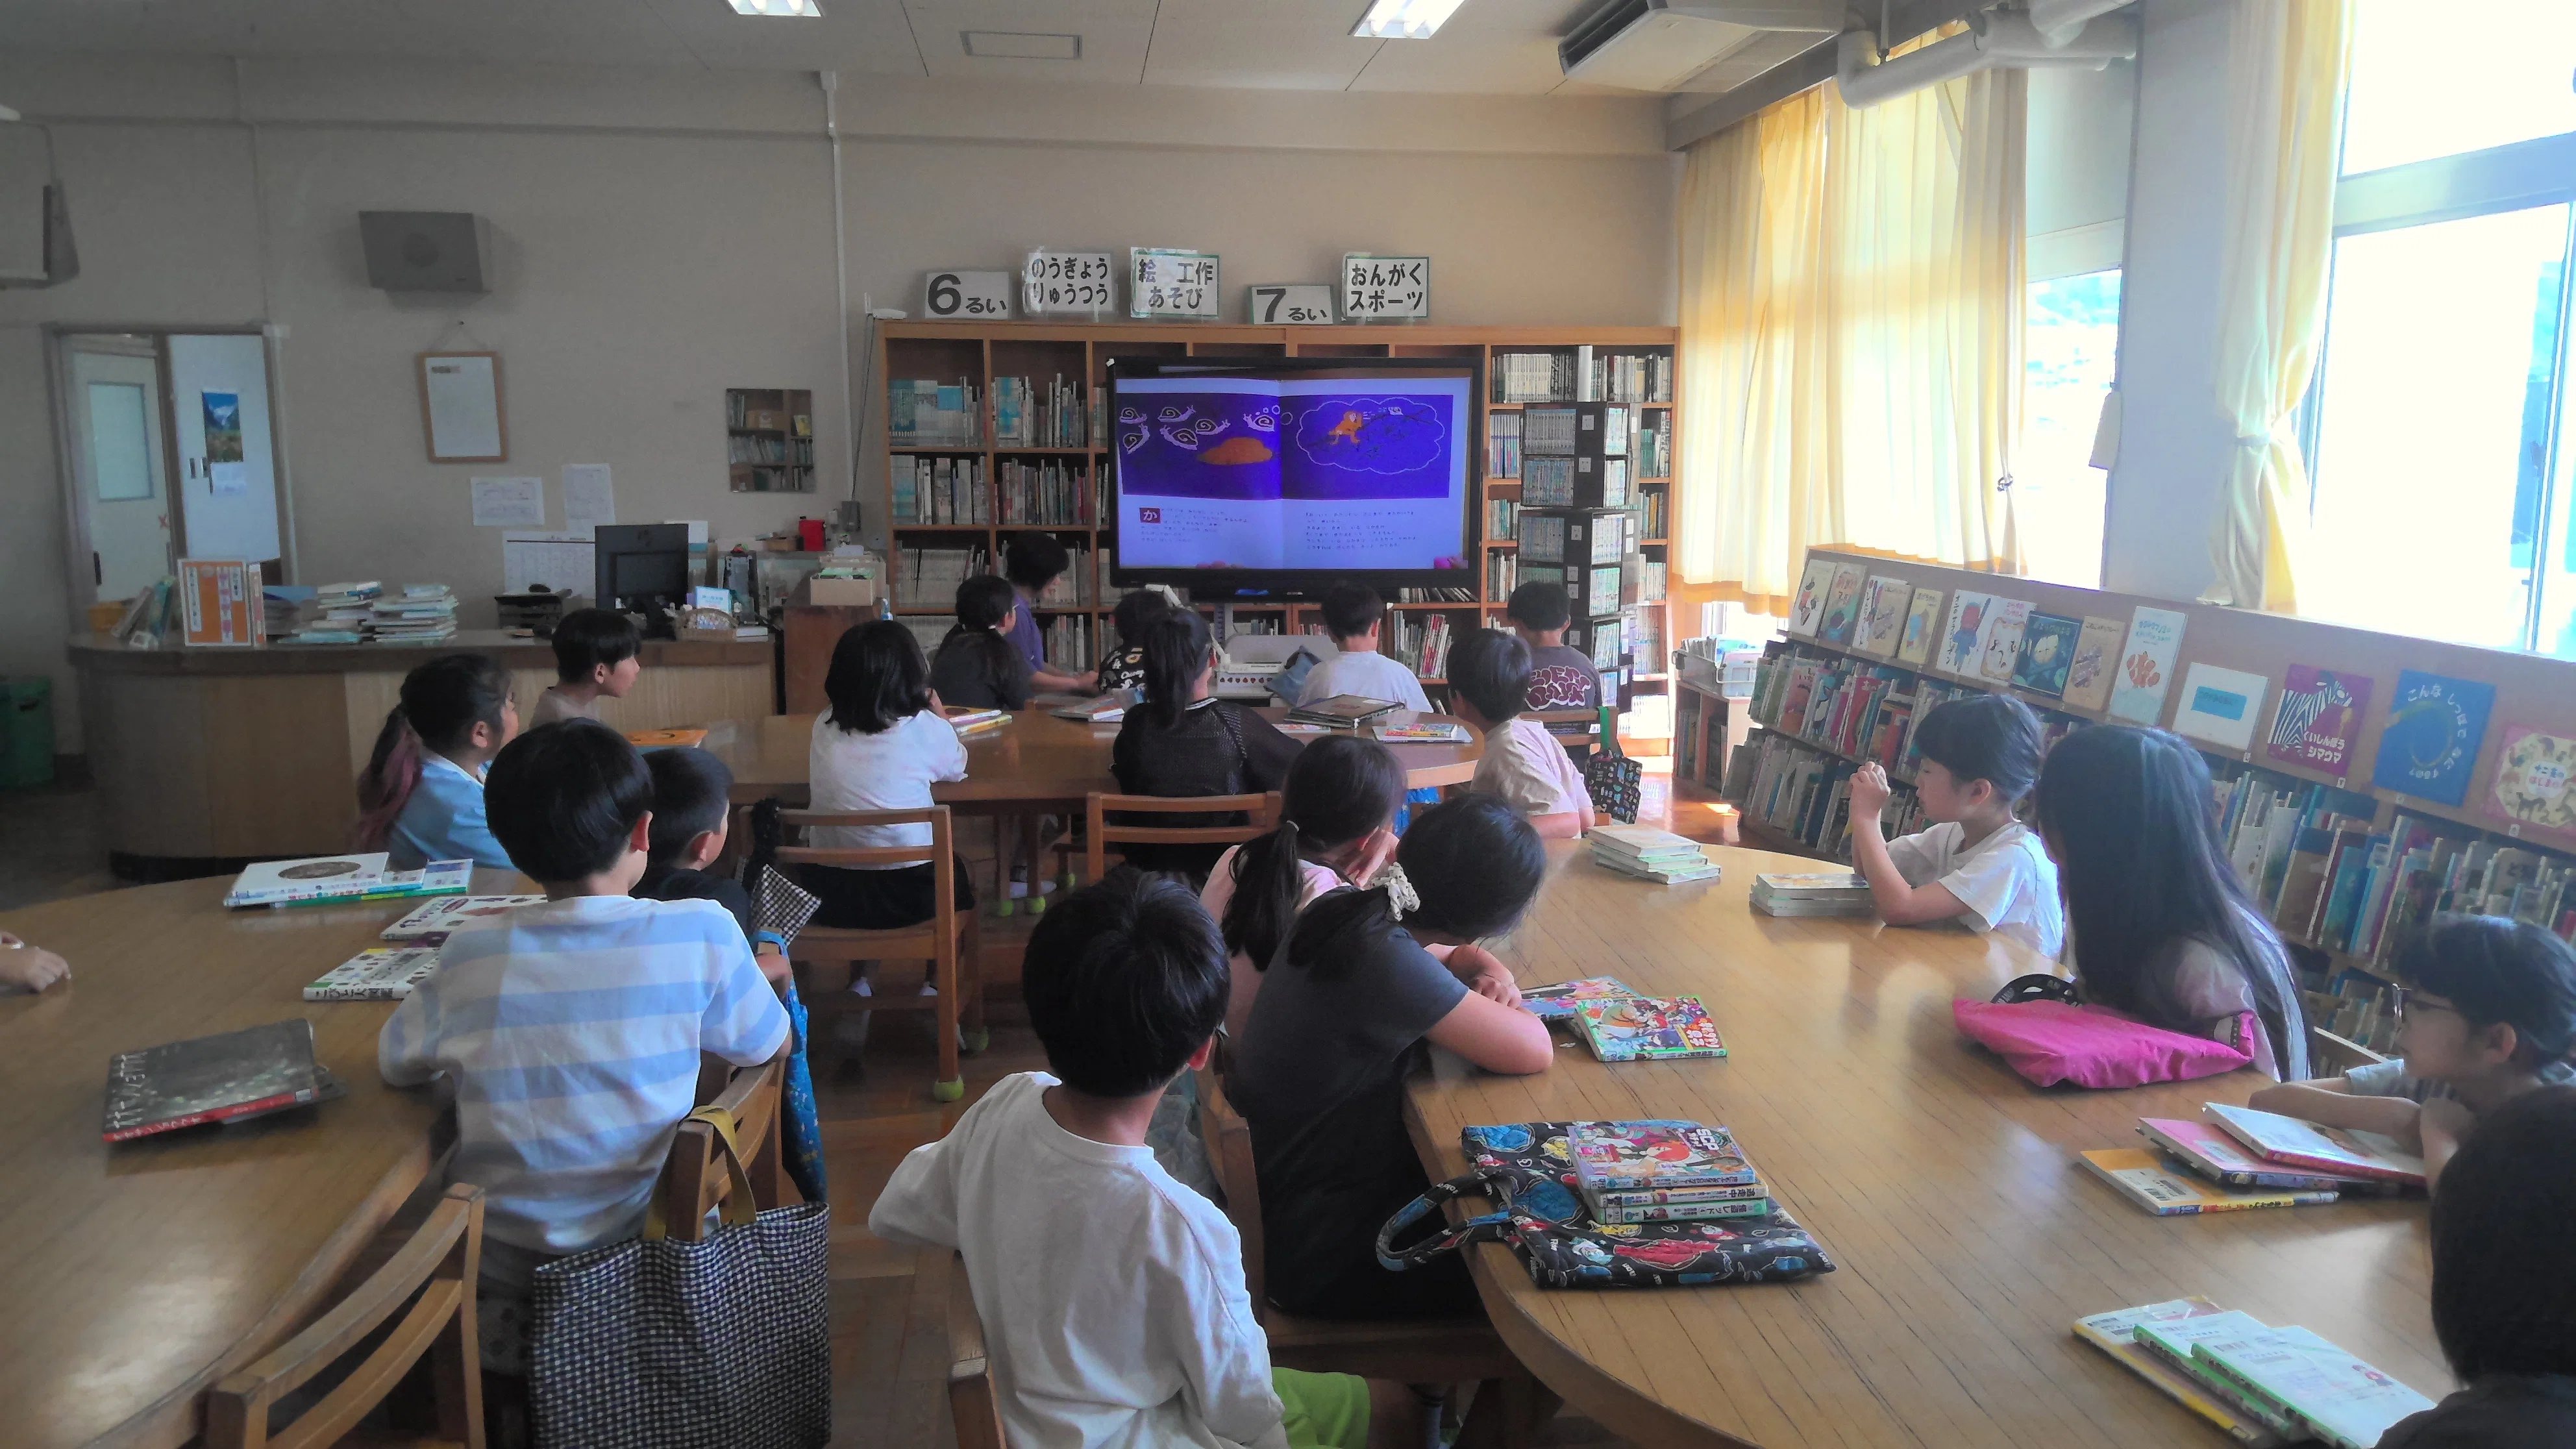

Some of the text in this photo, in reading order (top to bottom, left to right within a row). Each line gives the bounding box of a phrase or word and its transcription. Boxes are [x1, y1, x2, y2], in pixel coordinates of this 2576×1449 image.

[1032, 257, 1108, 279] のうぎょう
[1138, 259, 1213, 284] 絵 工作
[1350, 262, 1421, 287] おんがく
[928, 273, 1007, 315] 6るい
[1034, 283, 1108, 305] りゅうつう
[1148, 286, 1202, 310] あそび
[1256, 288, 1328, 322] 7るい
[1349, 290, 1423, 312] スポーツ
[1143, 510, 1158, 521] か
[2307, 746, 2342, 764] シマウマ
[1696, 1128, 1720, 1151] SCP
